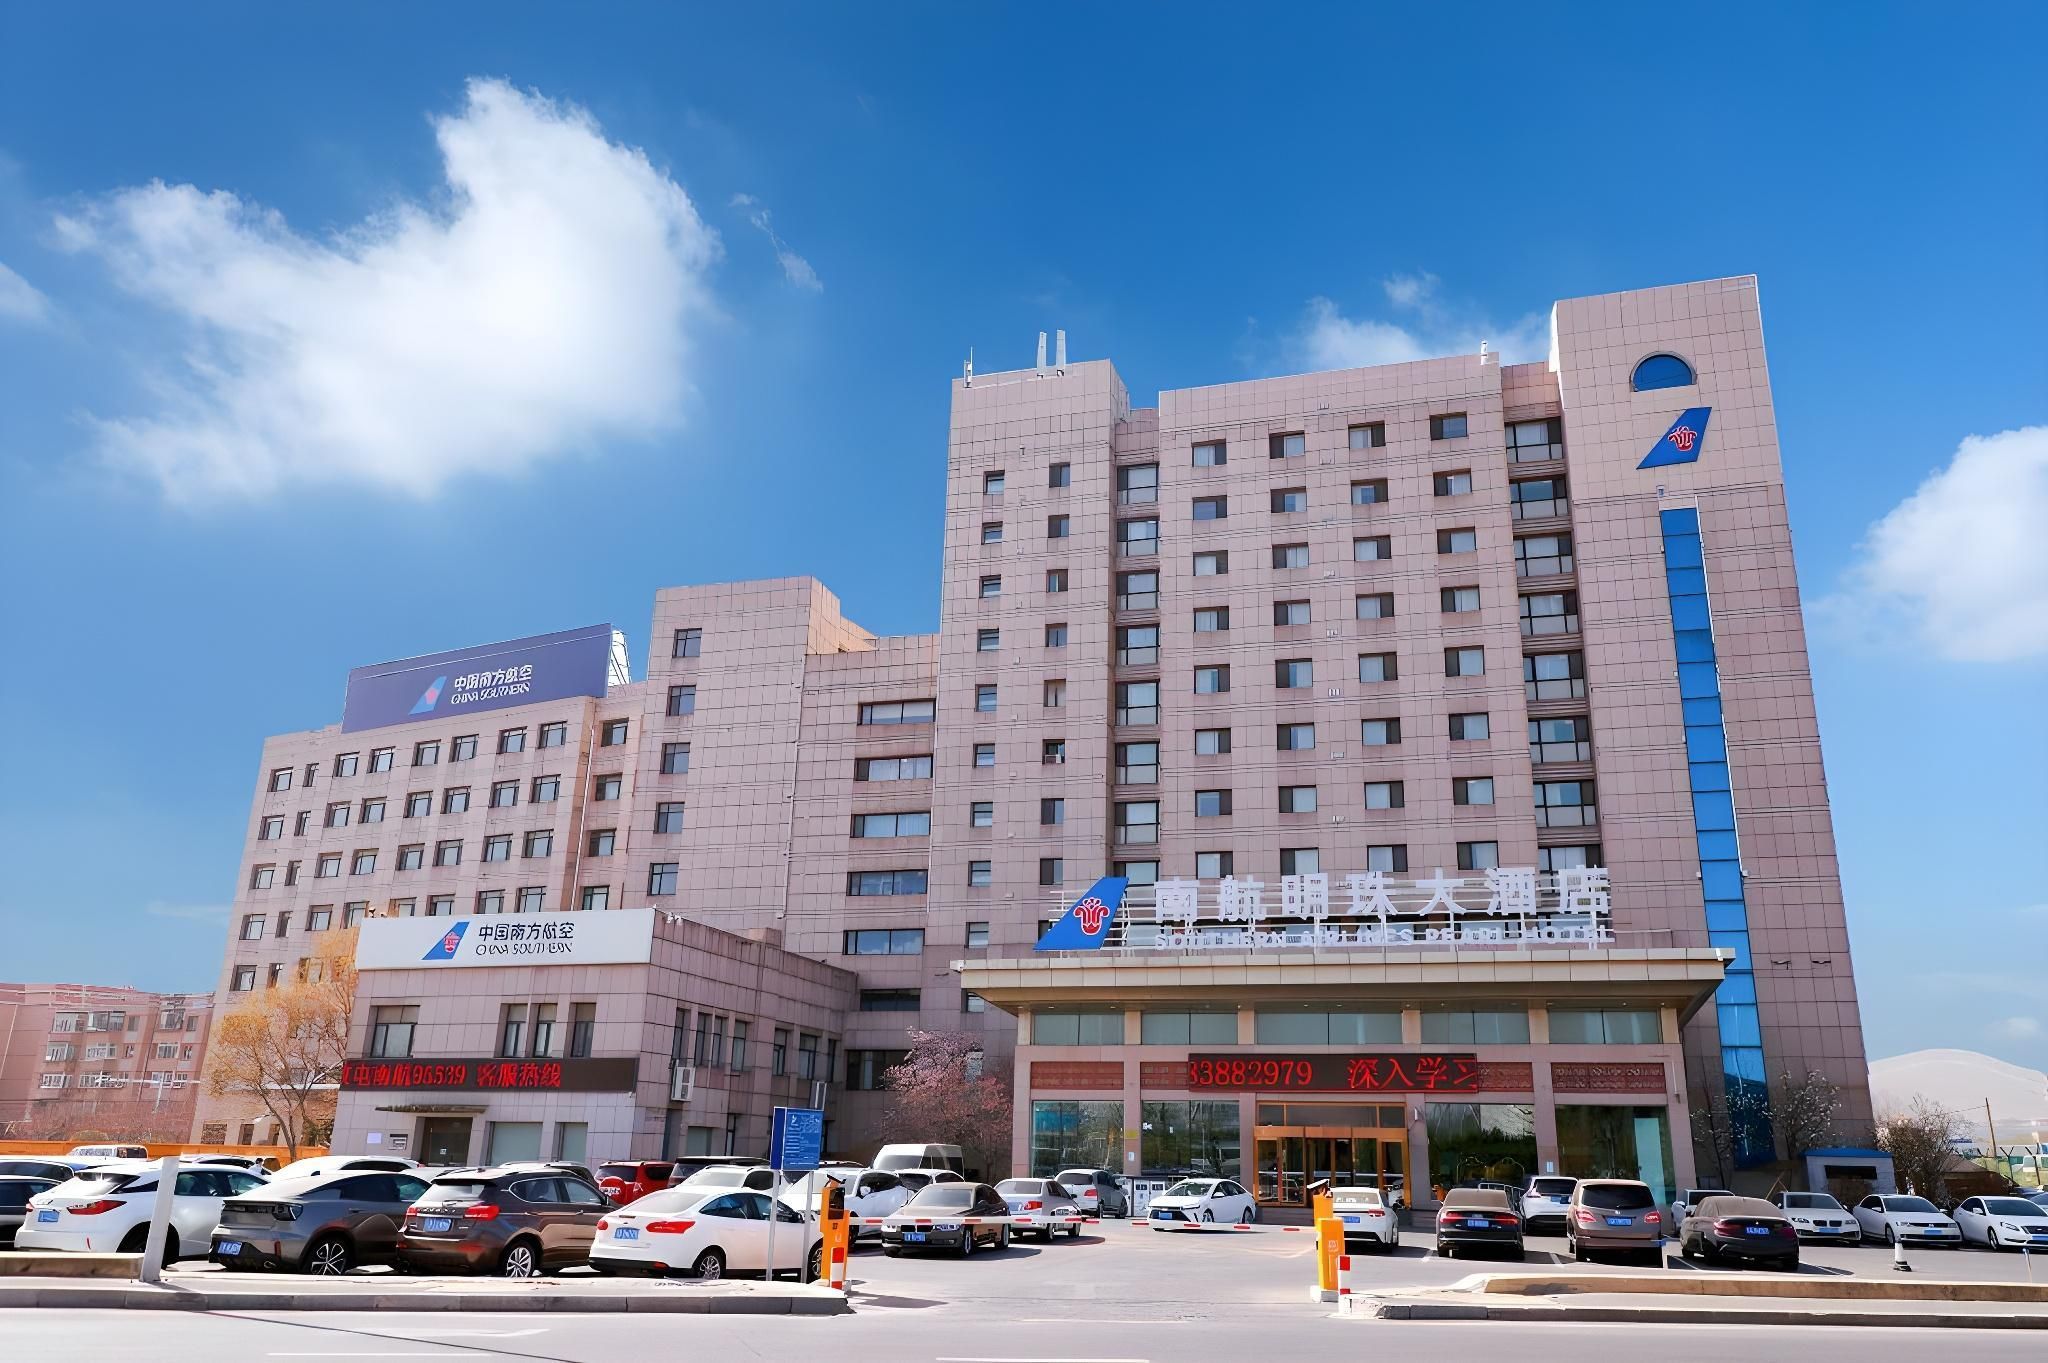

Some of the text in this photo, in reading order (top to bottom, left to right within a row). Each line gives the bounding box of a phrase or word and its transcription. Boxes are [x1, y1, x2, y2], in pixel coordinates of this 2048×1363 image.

[1154, 865, 1609, 923] 南航明珠大酒店
[478, 921, 575, 941] 中国南方航空
